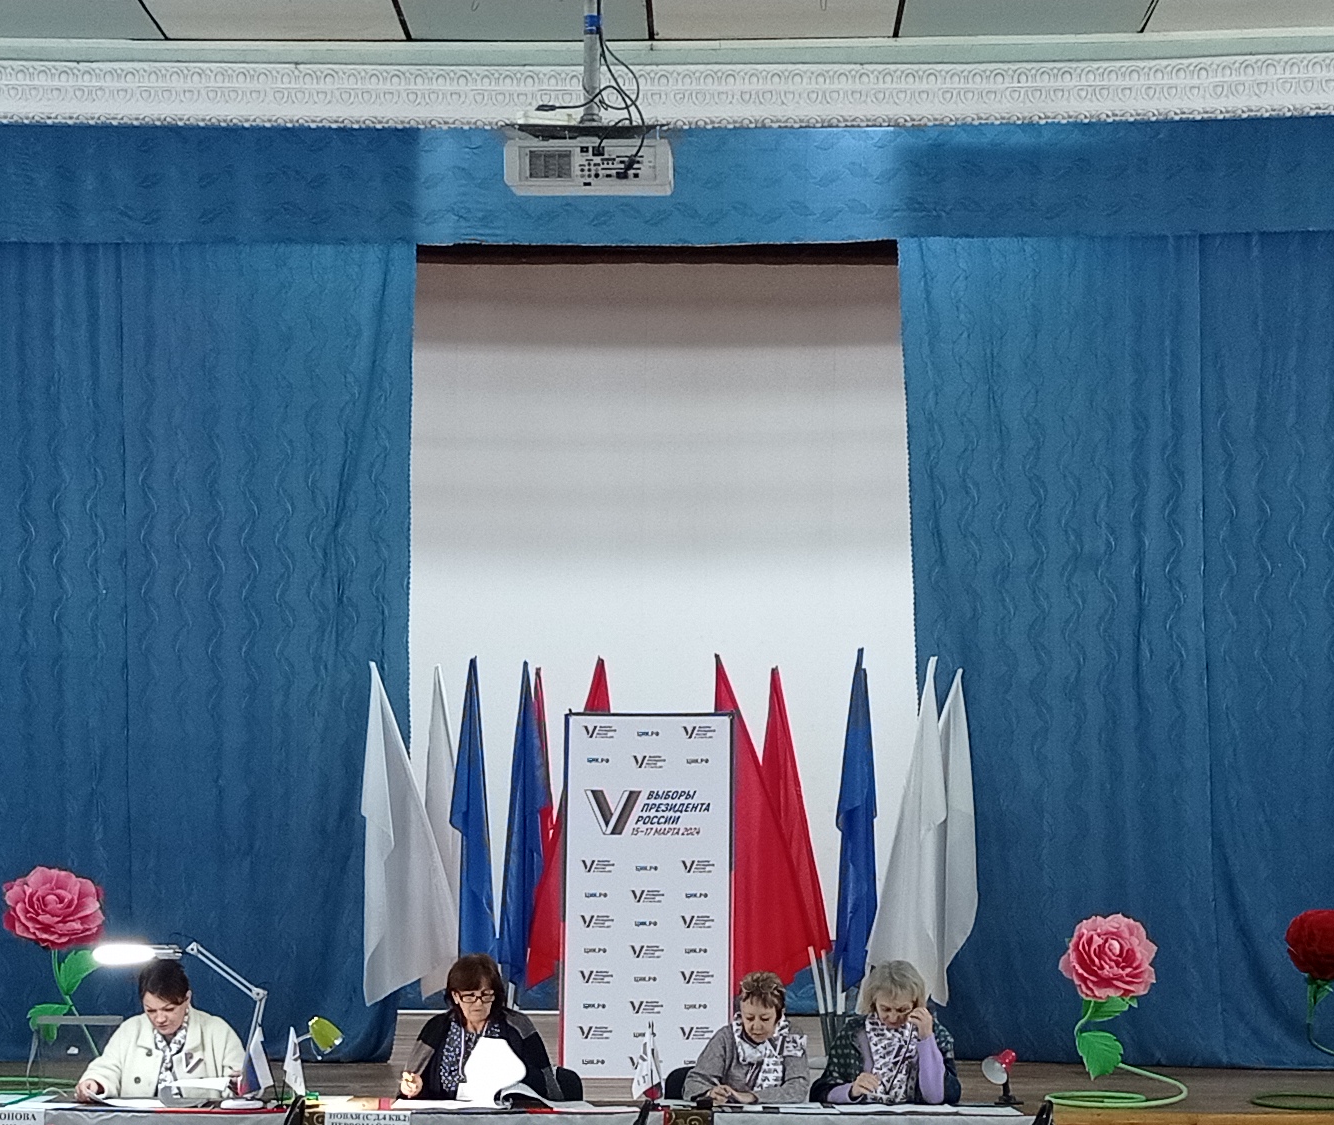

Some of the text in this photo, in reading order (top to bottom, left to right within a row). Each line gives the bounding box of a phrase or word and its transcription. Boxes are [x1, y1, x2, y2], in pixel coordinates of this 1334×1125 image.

[646, 790, 697, 800] ВЫБОРЫ
[641, 802, 711, 813] ПРЕЗИДЕНТА
[635, 815, 681, 825] РОССИИ
[653, 827, 681, 836] МАРТА
[681, 827, 701, 836] 2024
